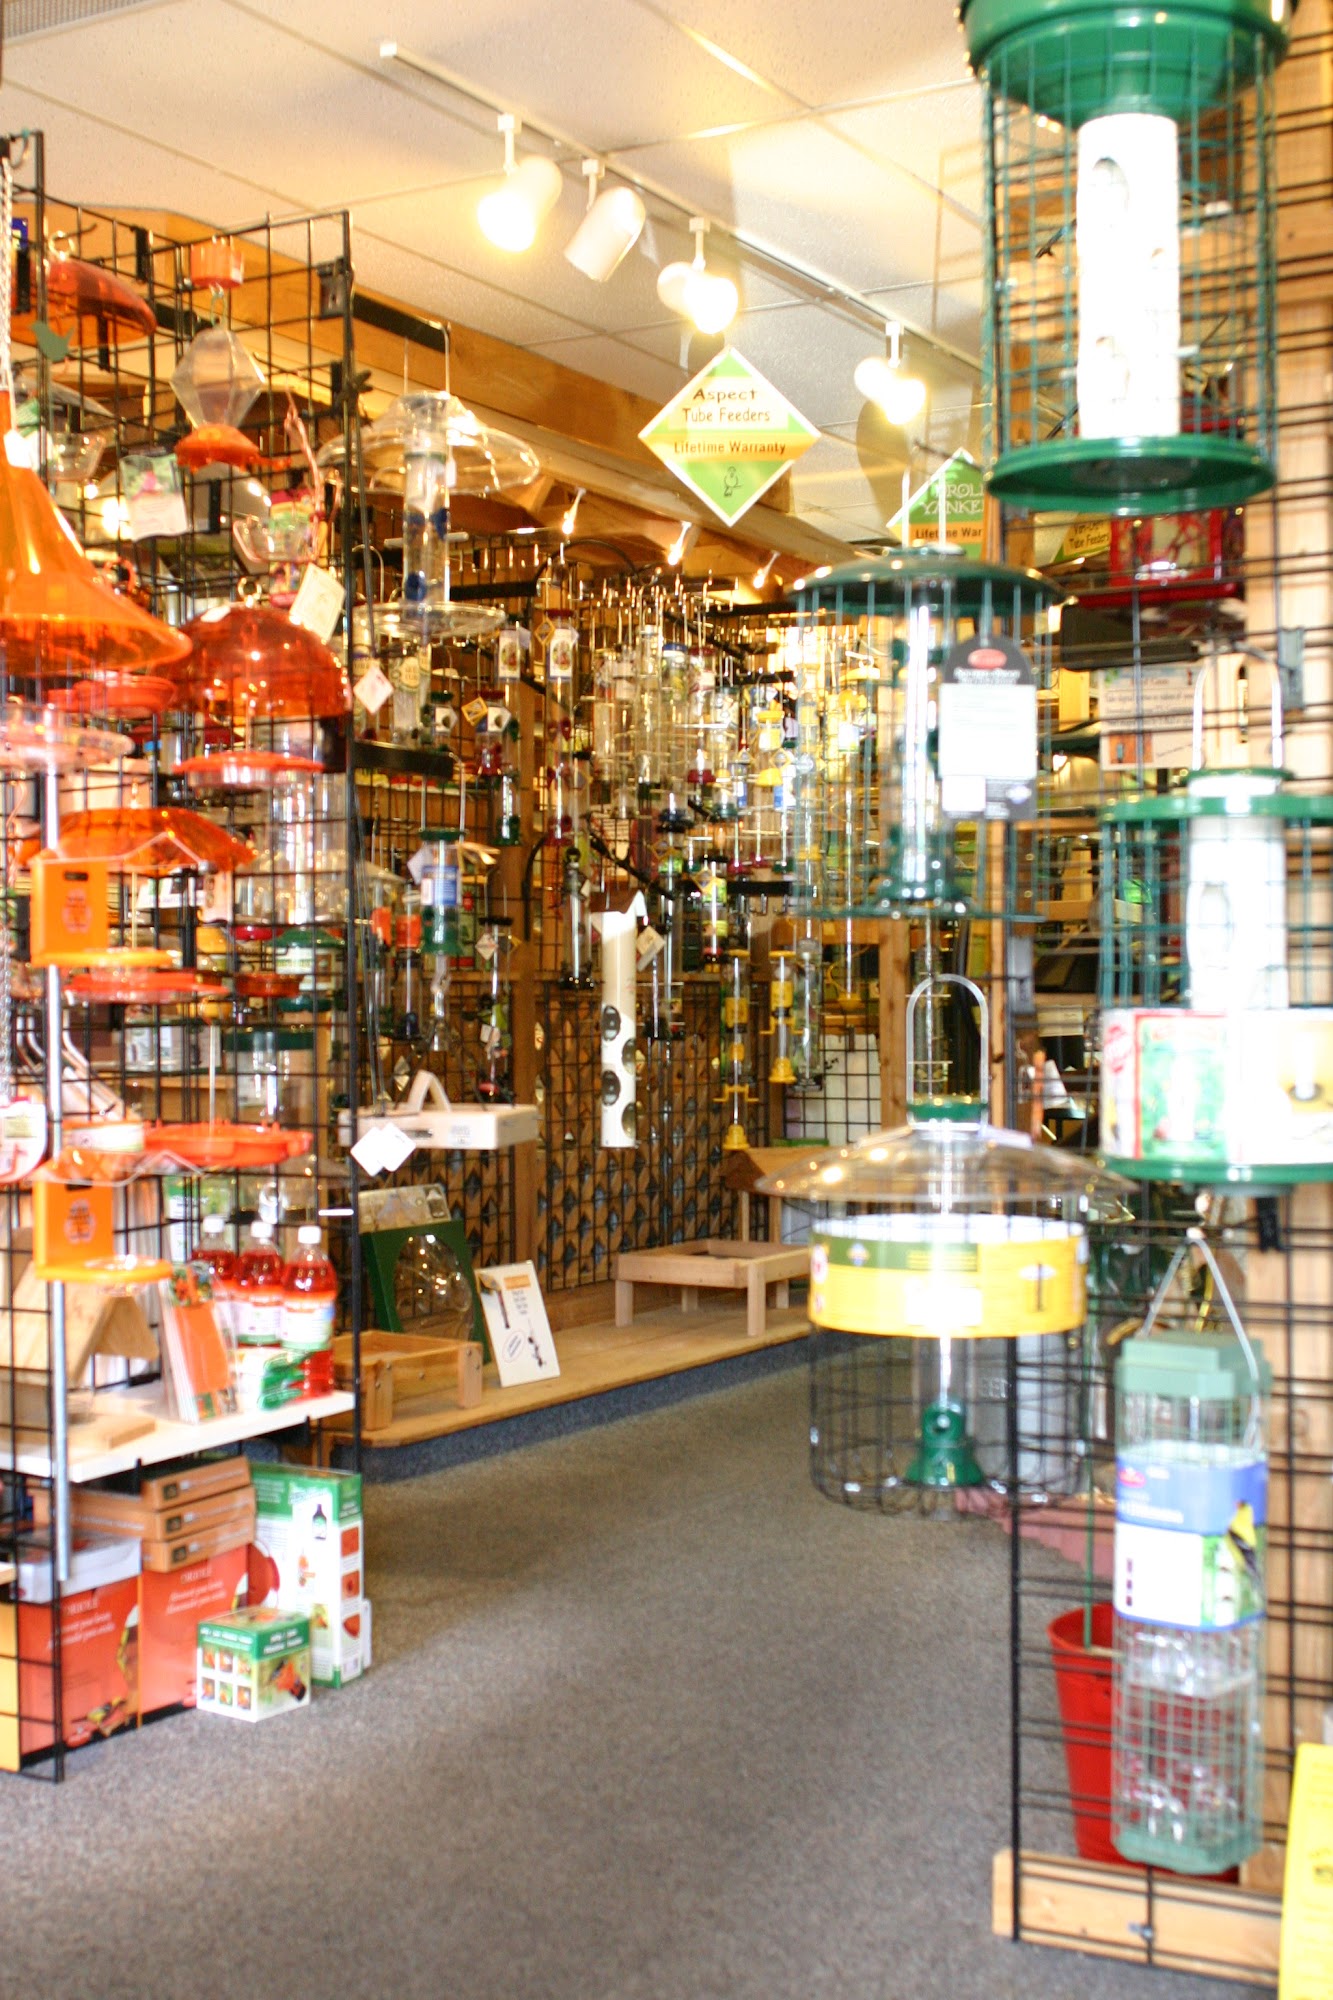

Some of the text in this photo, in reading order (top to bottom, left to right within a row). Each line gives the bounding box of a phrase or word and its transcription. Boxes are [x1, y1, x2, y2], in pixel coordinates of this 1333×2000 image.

[692, 387, 757, 404] Aspect
[682, 406, 771, 423] Tube Feeders
[674, 440, 787, 456] Lifetime Warranty
[920, 499, 984, 515] YANKE
[915, 526, 983, 539] Lifetme War
